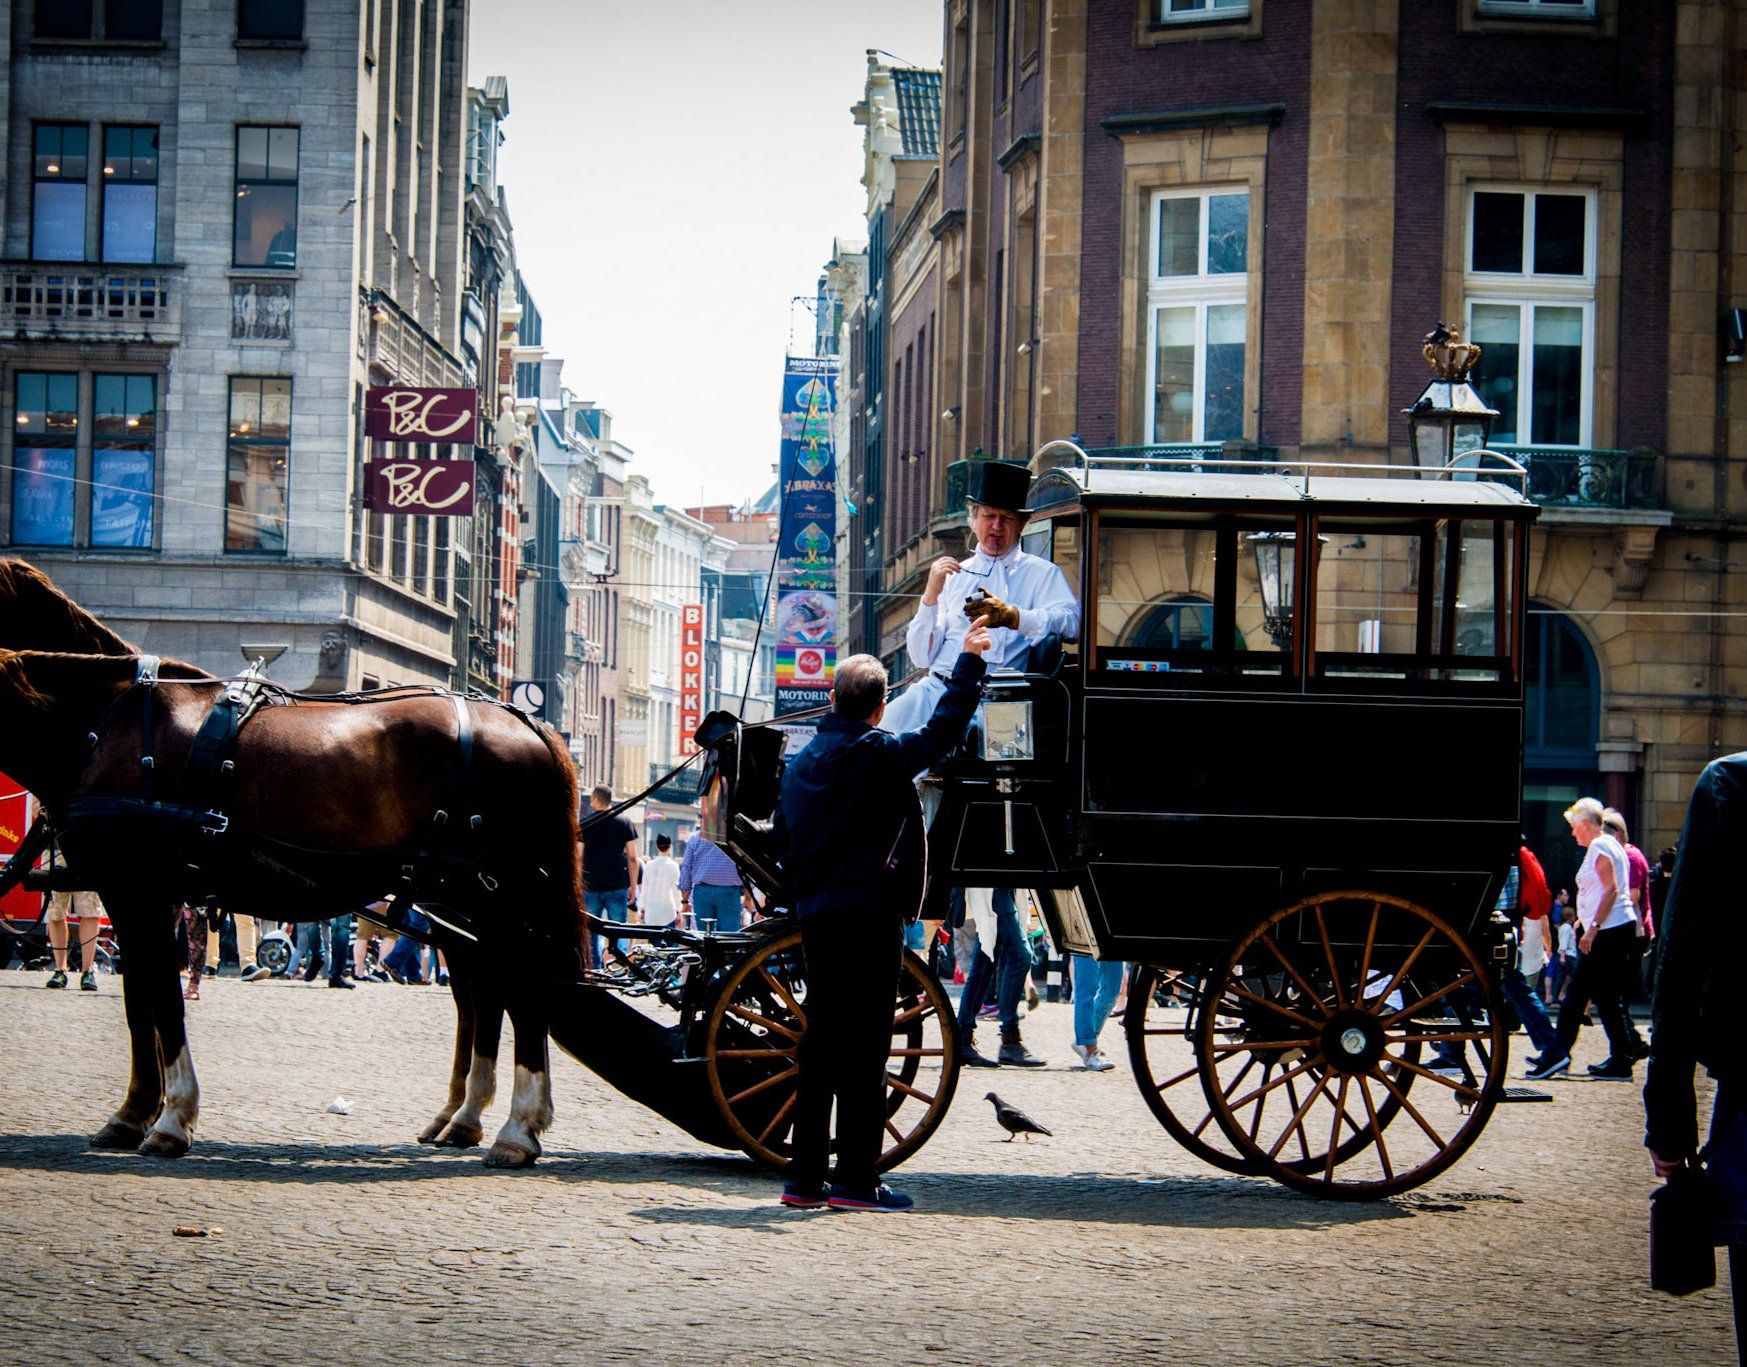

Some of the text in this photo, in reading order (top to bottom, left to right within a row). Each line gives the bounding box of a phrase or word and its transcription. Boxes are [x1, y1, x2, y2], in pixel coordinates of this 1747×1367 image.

[381, 391, 471, 437] P&C
[380, 463, 470, 509] P&C
[683, 607, 700, 754] BLOKKER
